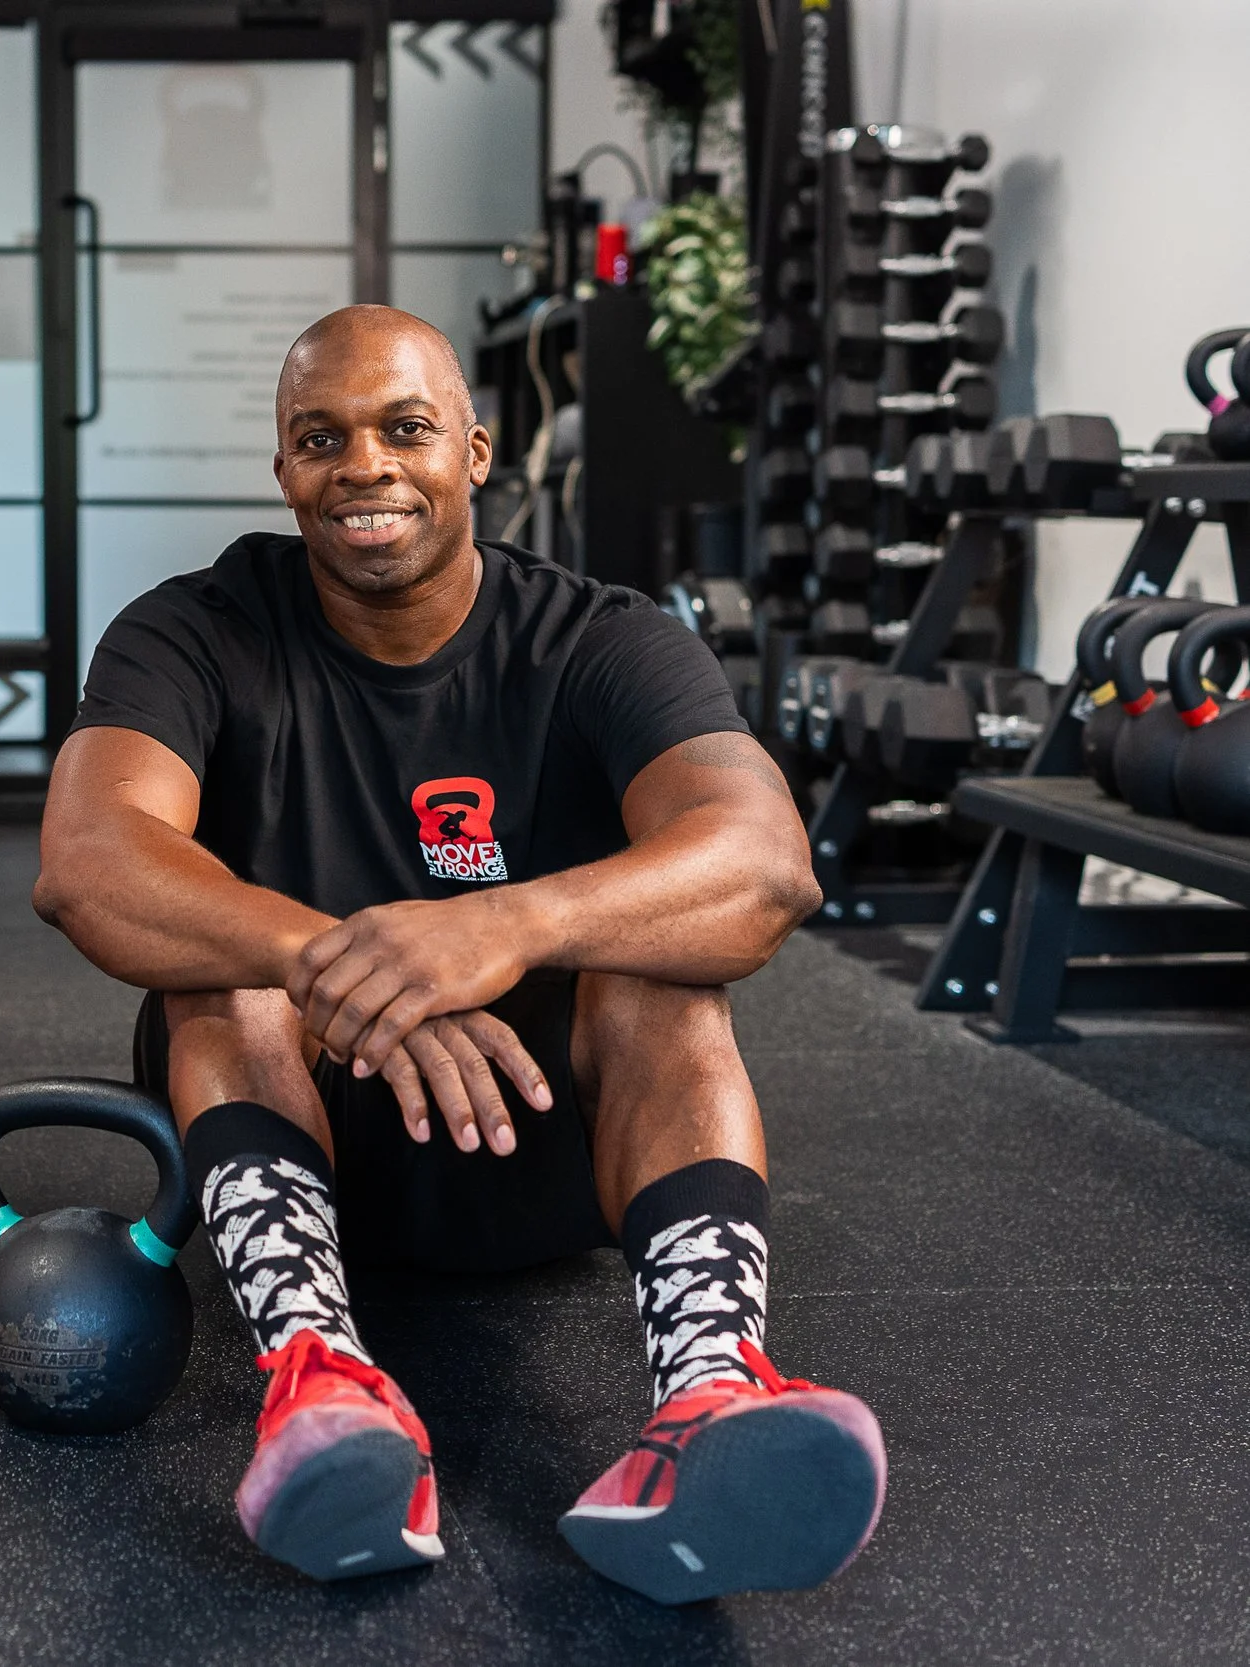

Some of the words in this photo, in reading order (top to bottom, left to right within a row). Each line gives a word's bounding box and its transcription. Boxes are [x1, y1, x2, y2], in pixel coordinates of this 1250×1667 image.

[419, 842, 494, 864] MOVE
[493, 841, 508, 876] LONDON
[427, 859, 501, 877] STRONG
[40, 1352, 97, 1366] FASTER
